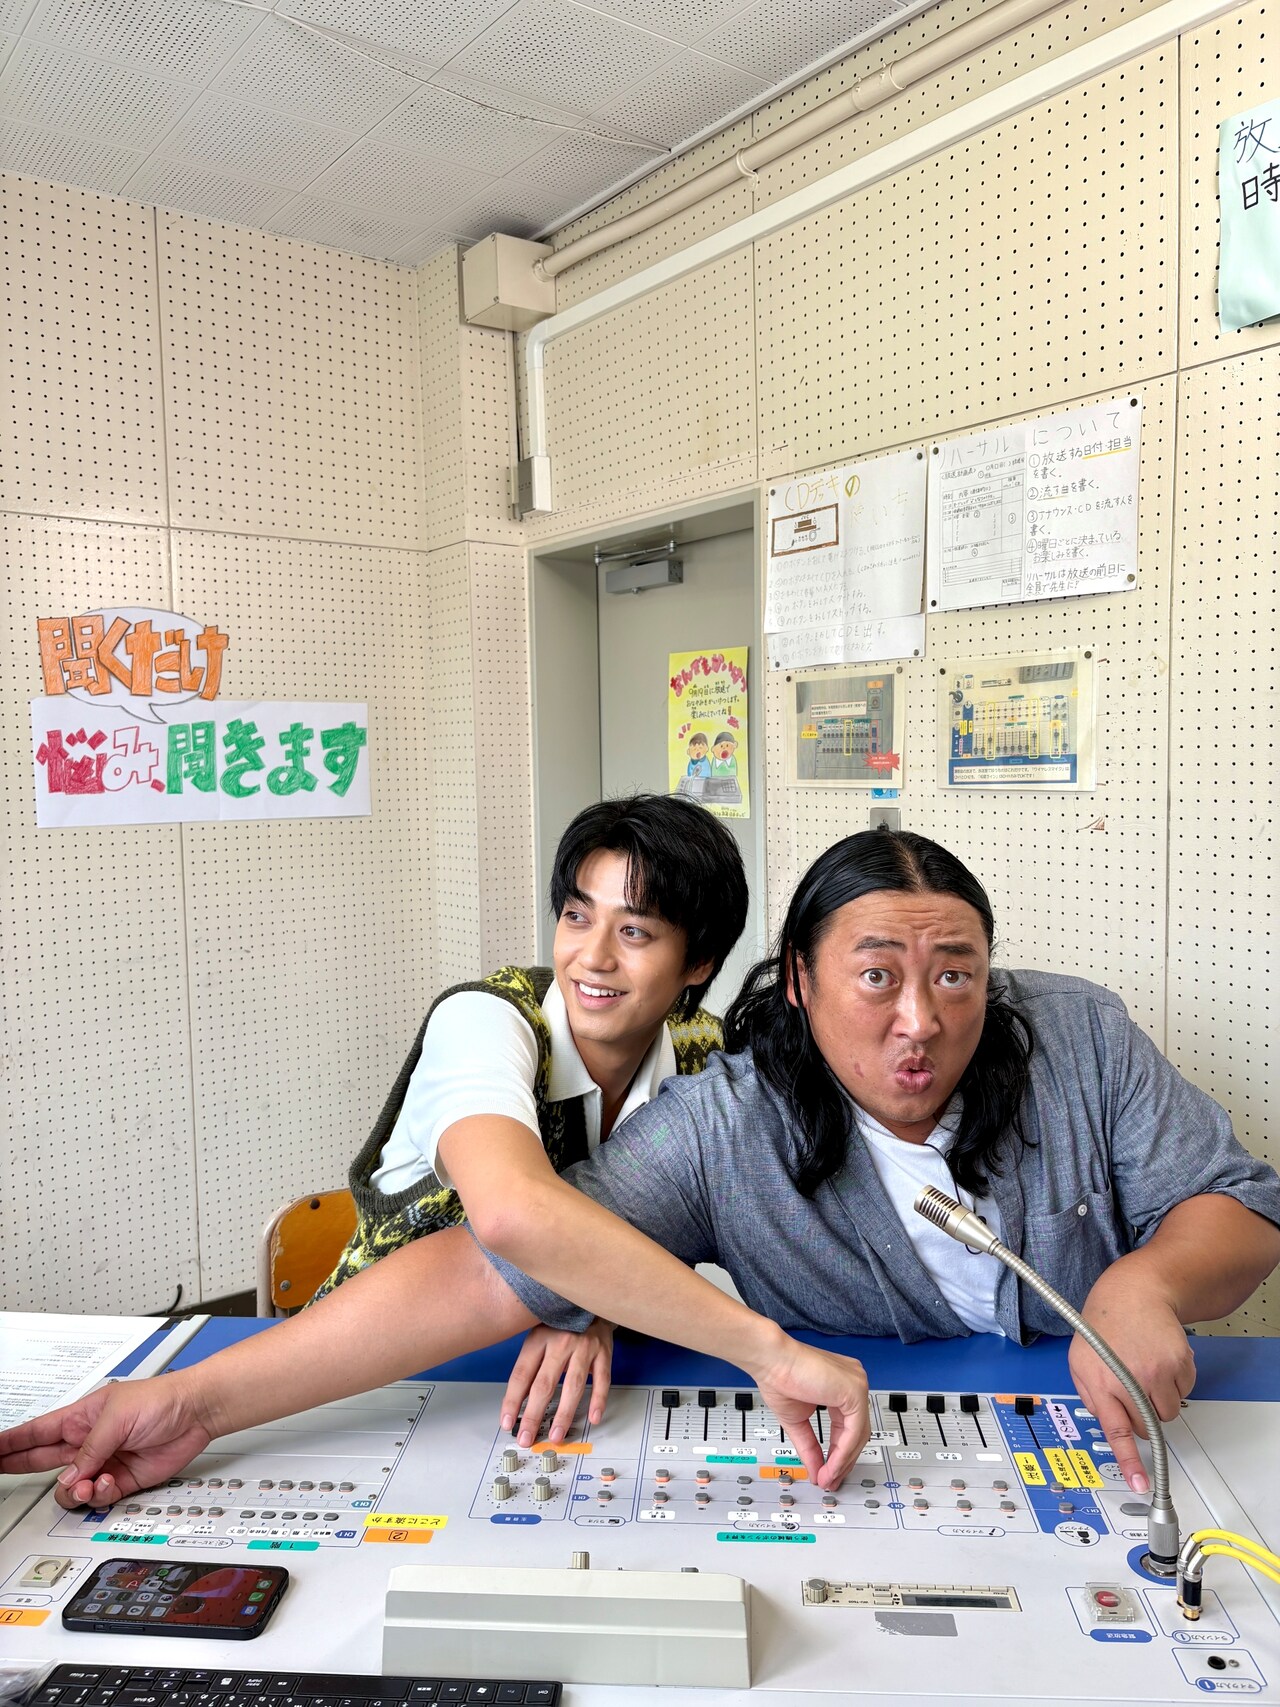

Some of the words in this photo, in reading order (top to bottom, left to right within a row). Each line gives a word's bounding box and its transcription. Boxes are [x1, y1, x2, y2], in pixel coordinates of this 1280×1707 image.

[1233, 118, 1280, 163] 放
[1033, 411, 1120, 446] について
[37, 615, 230, 701] 聞くだけ
[1023, 1456, 1040, 1480] 注意!
[371, 1516, 441, 1525] どこに流すか
